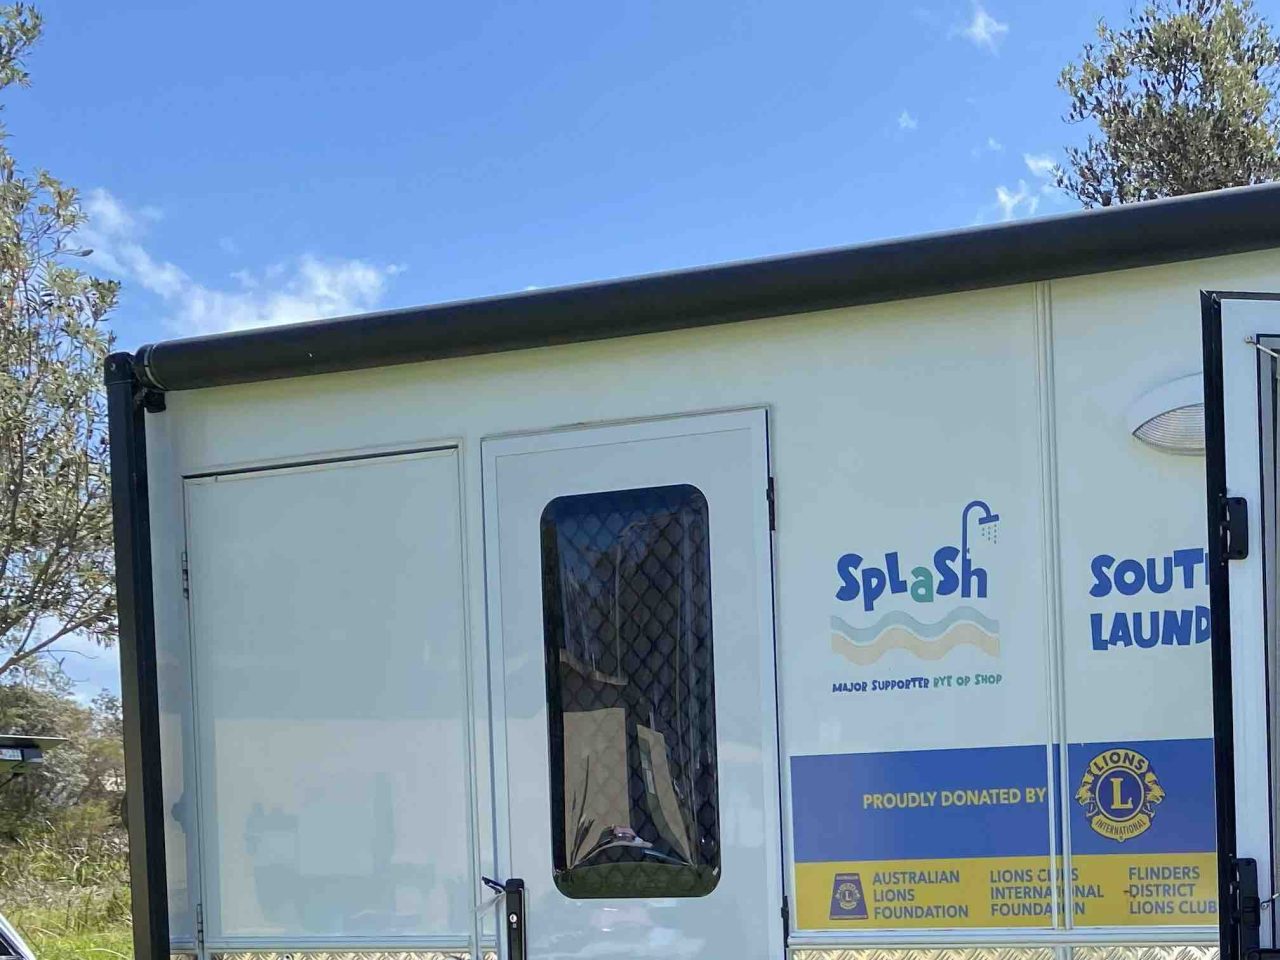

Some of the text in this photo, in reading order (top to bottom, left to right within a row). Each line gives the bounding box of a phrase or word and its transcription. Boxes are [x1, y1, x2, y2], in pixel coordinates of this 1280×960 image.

[832, 673, 1003, 692] MAJOR SUPPORTER RYE OP SHOP
[1093, 751, 1146, 773] LIONS
[863, 787, 1047, 809] PROUDLY DONATED BY
[1109, 777, 1134, 809] L
[1095, 818, 1147, 837] INTERNATIONAL
[872, 869, 960, 885] AUSTRALIAN
[990, 869, 1033, 883] LIONS
[1128, 866, 1201, 880] FLINDERS
[873, 889, 915, 902] LIONS
[1129, 883, 1196, 897] DISTRICT
[874, 905, 969, 920] FOUNDATION
[1129, 900, 1218, 914] LIONS CLUB
